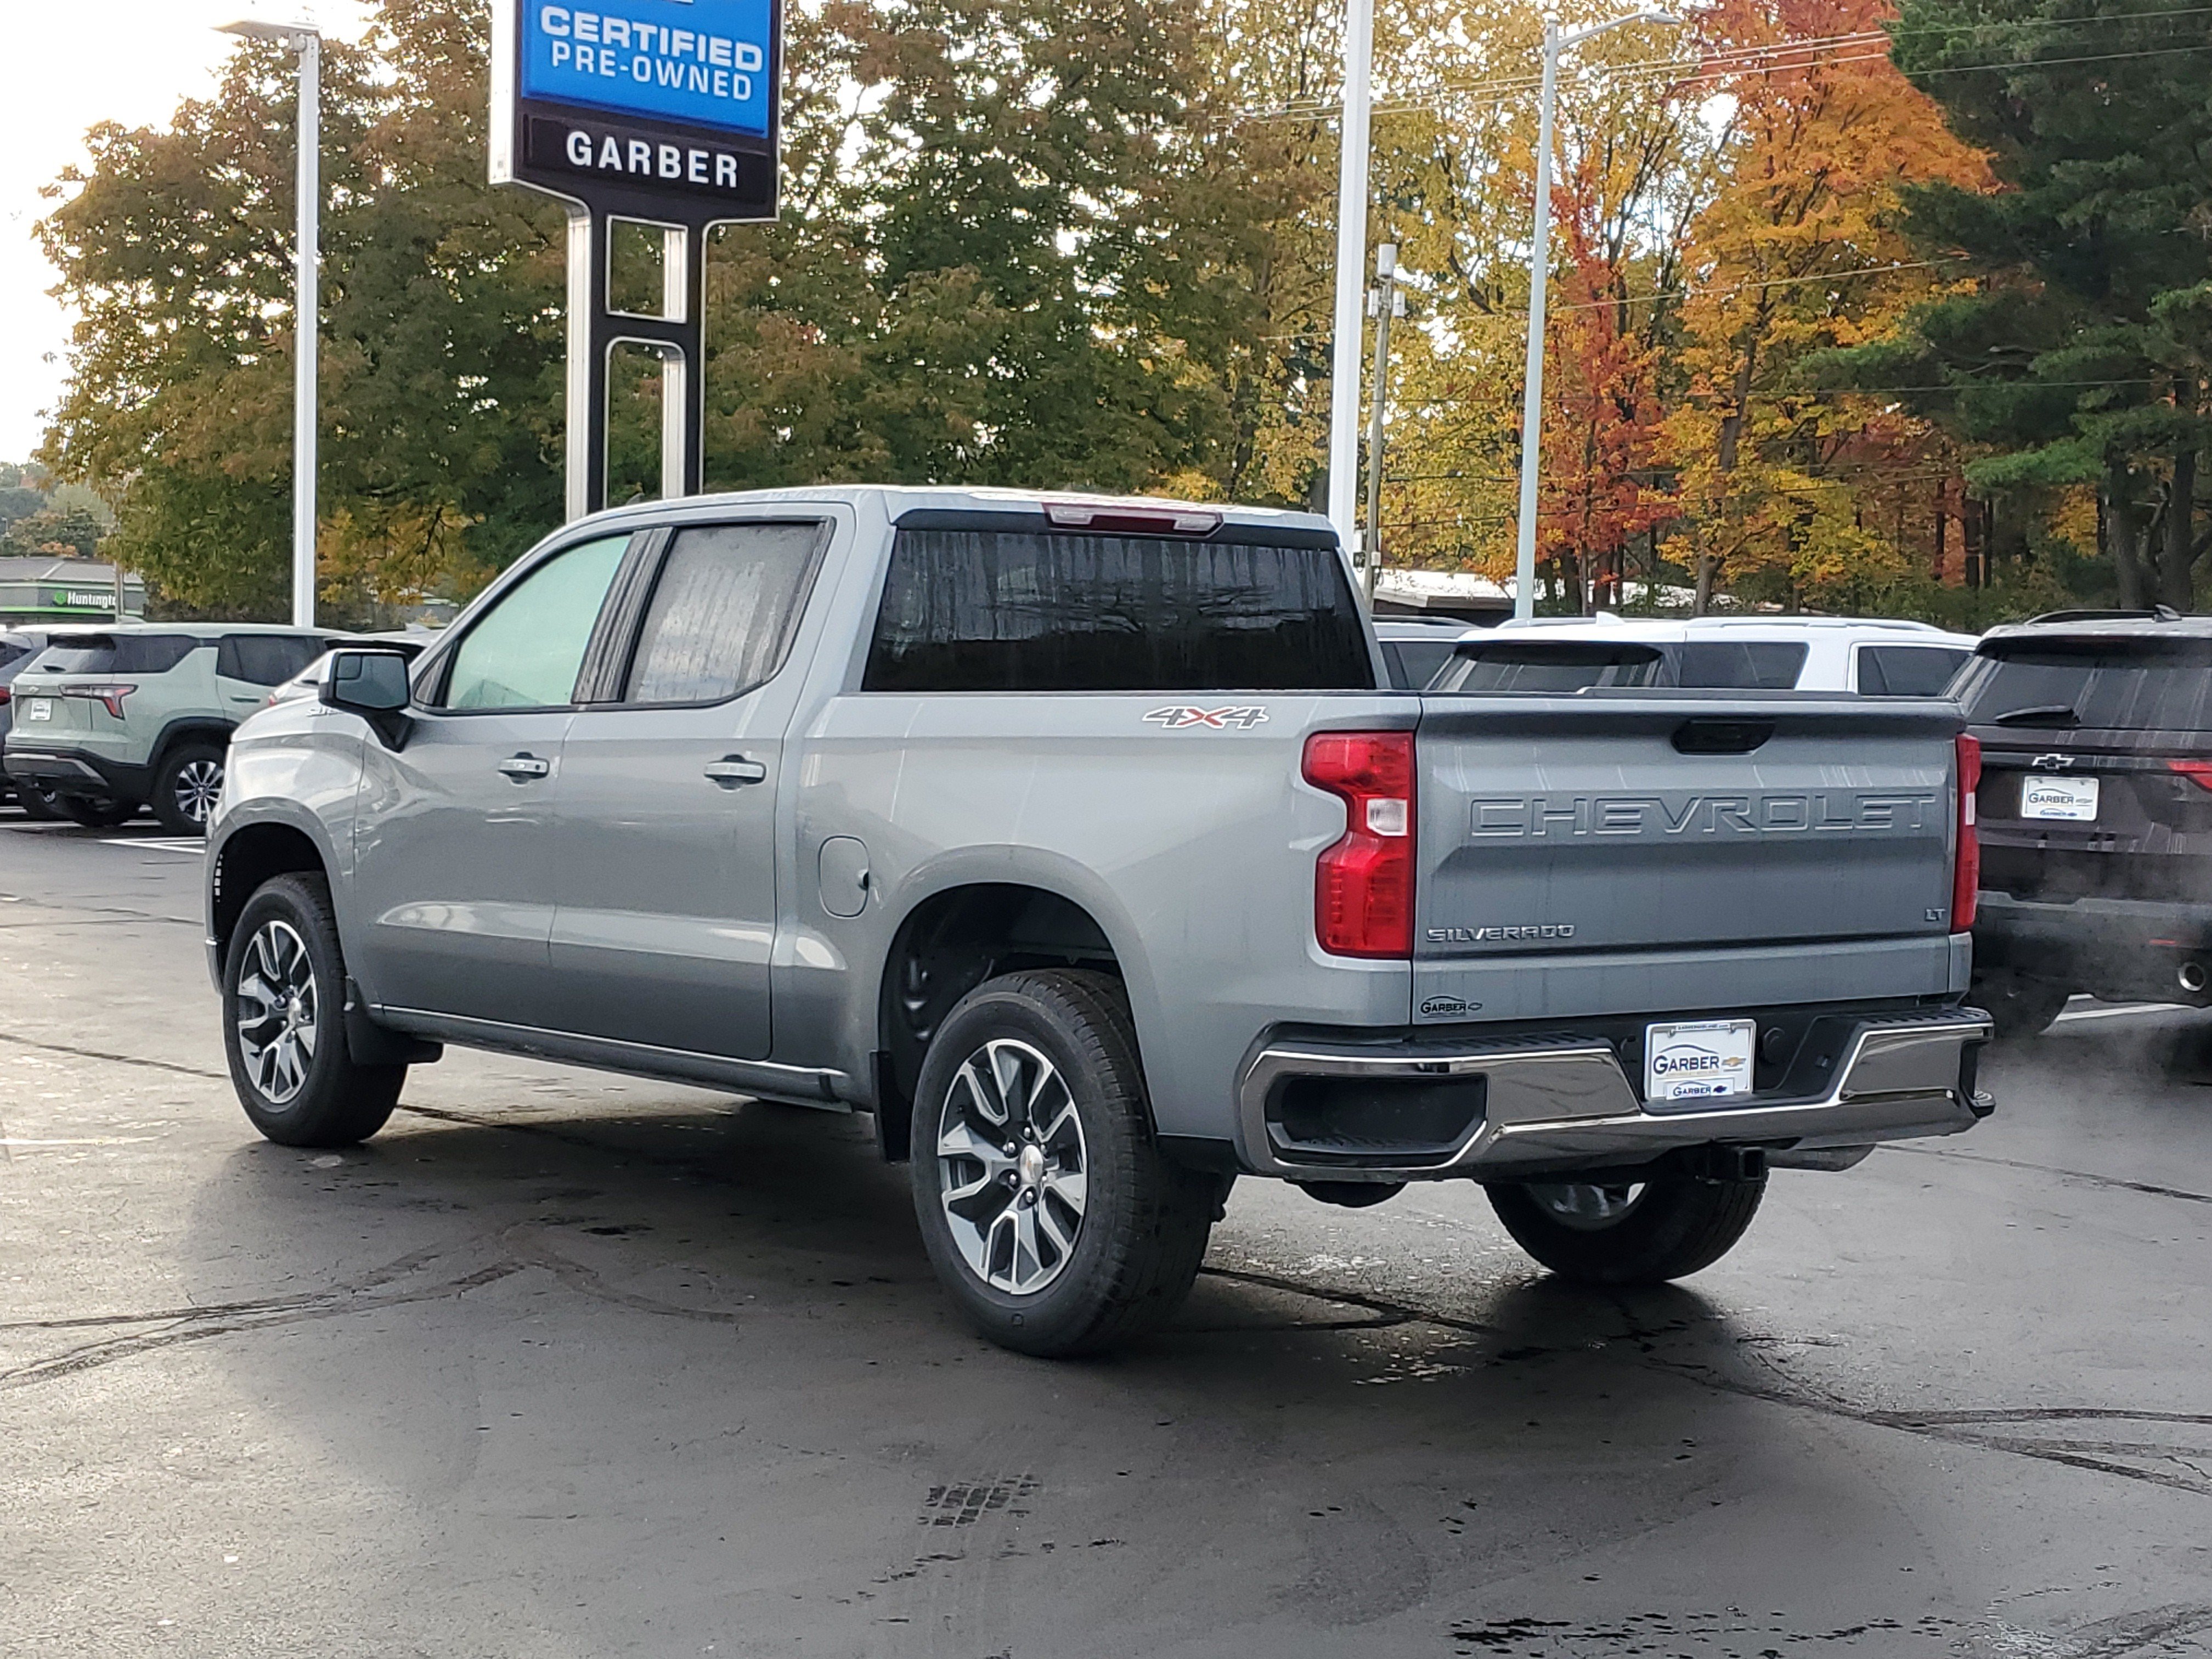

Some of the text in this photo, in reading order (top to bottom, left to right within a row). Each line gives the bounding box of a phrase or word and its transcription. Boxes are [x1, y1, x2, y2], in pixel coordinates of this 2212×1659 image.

[540, 7, 763, 72] CERTIFIED
[552, 41, 752, 101] PRE-OWNED
[566, 131, 738, 188] GARBER
[2029, 793, 2074, 804] GARBER
[1470, 793, 1936, 836] CHEVROLET
[1925, 908, 1945, 921] LT
[1426, 924, 1575, 942] SILVERADO
[1420, 1002, 1466, 1013] GARBER
[1653, 1055, 1719, 1075] GARBER
[1673, 1086, 1711, 1096] GARBER
